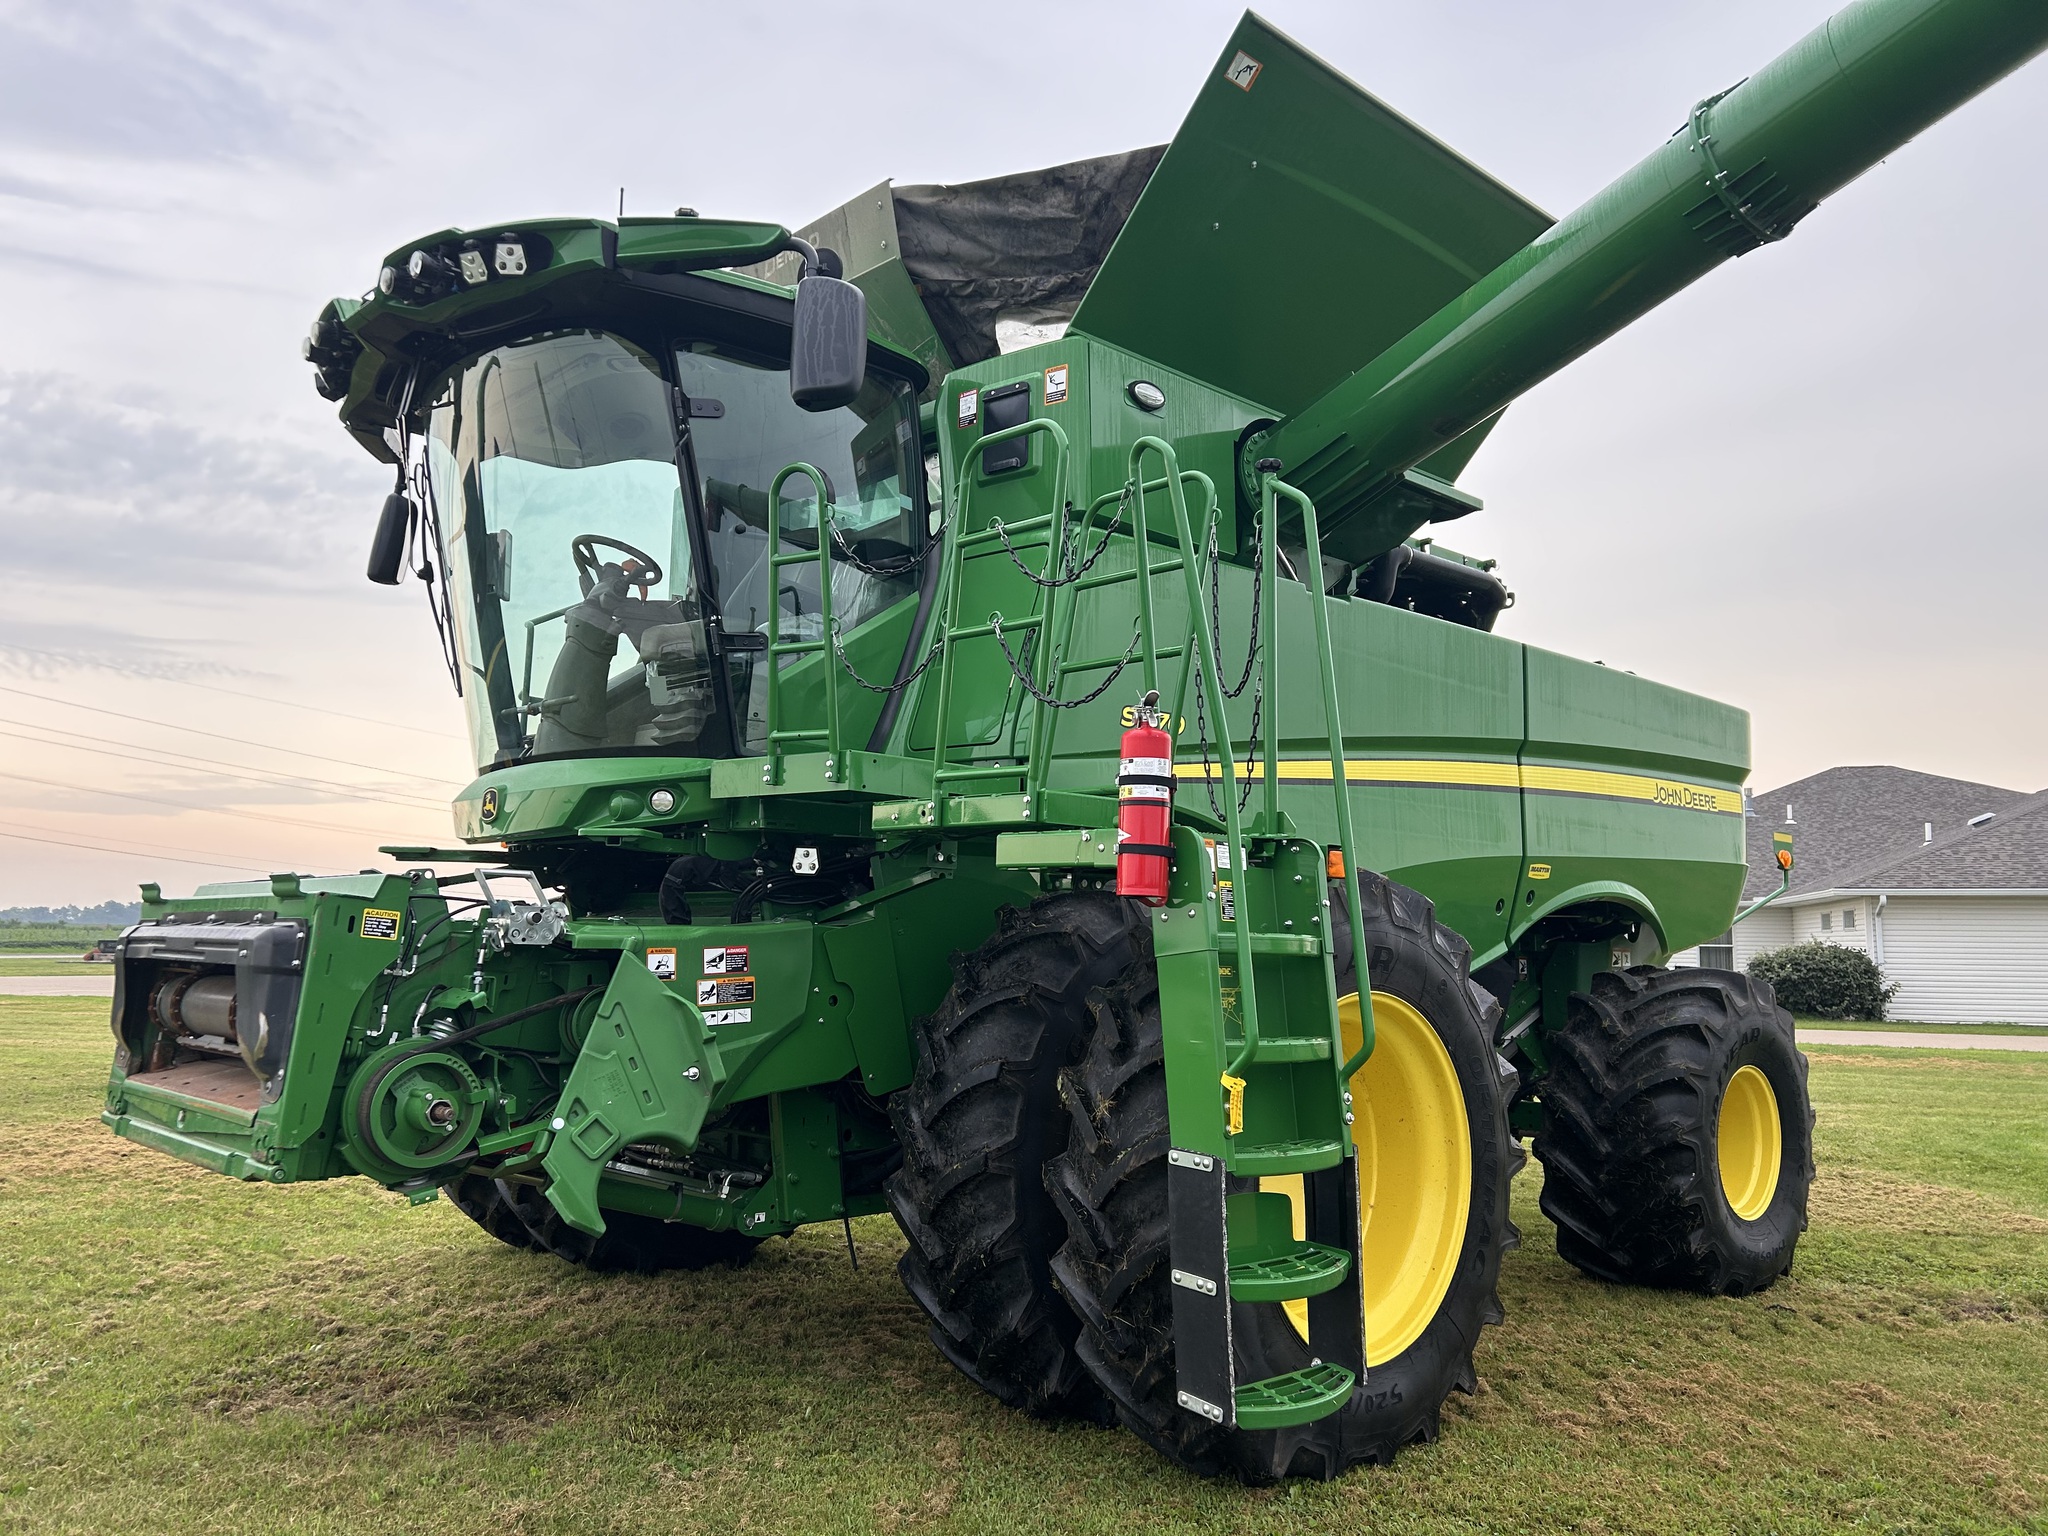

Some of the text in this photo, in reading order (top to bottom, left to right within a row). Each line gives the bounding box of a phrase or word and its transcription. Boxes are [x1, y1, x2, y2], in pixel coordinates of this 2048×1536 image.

[764, 231, 820, 280] DEMO
[1120, 706, 1186, 735] S70
[1654, 783, 1718, 809] JOHN DEERE
